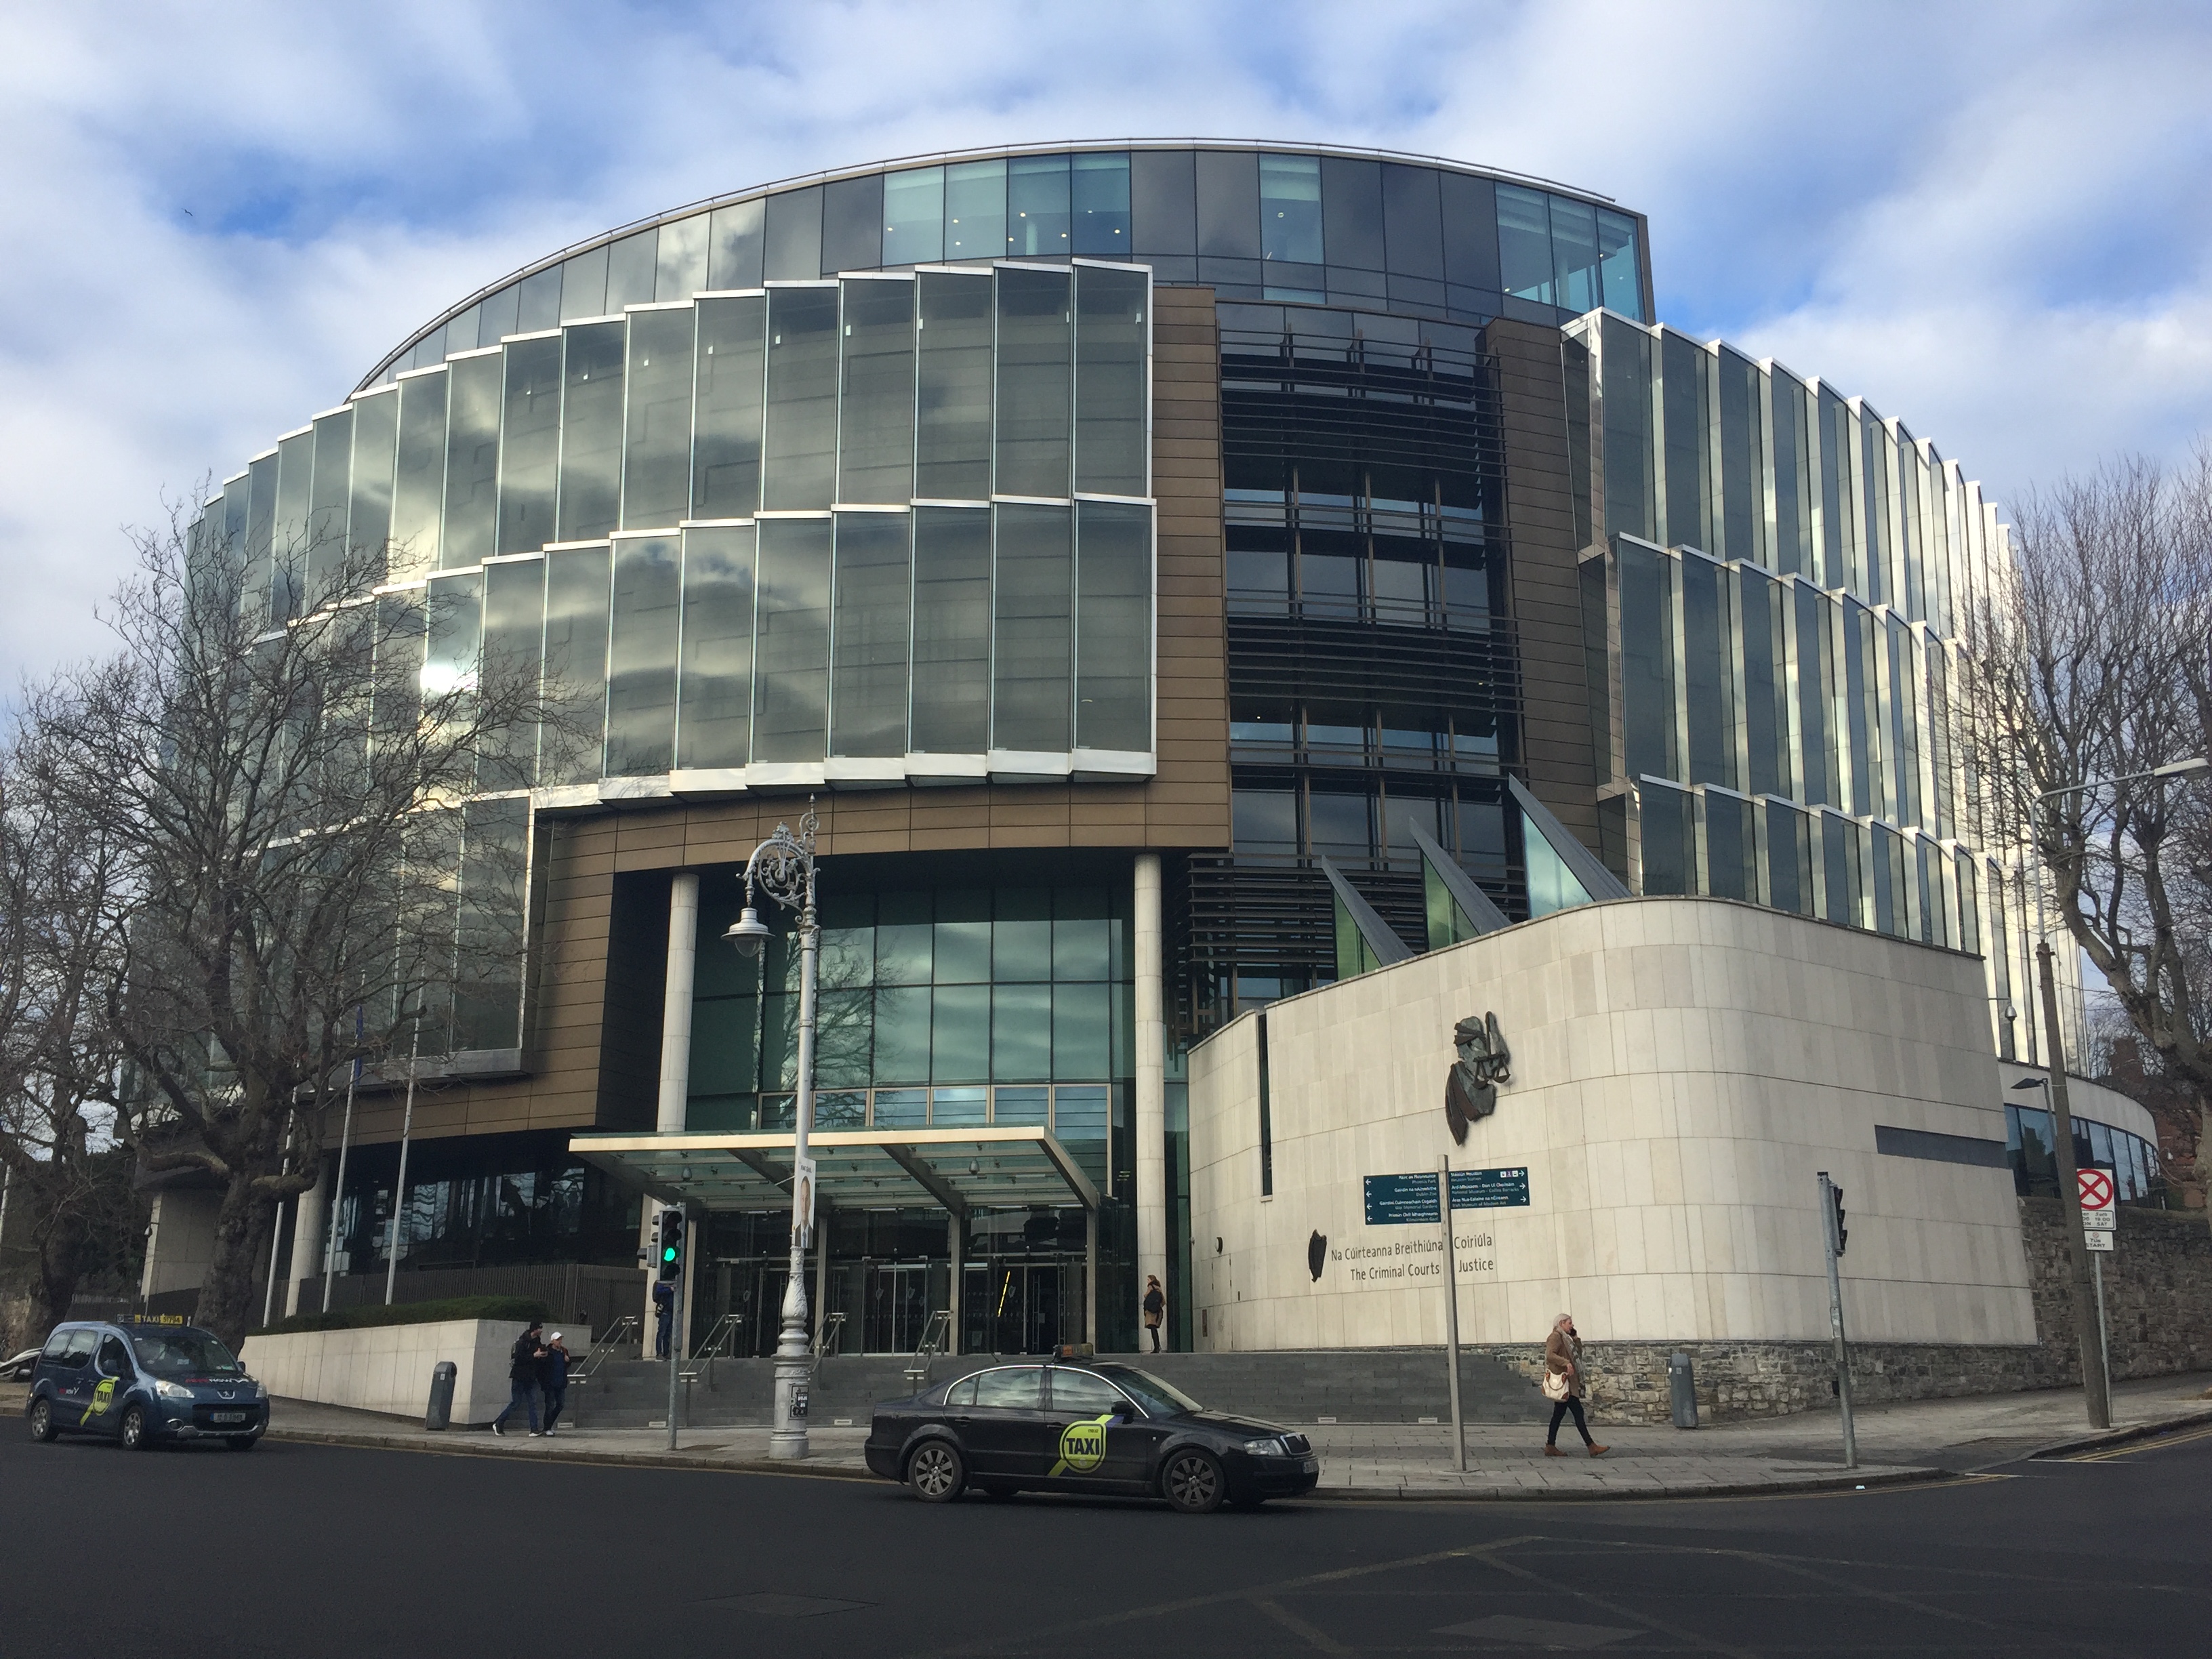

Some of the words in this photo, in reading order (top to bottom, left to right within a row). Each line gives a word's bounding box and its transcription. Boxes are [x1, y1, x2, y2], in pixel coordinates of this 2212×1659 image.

[1331, 1250, 1342, 1261] Na
[1345, 1246, 1392, 1261] Cúirteanna
[1395, 1240, 1443, 1256] Breithiúna
[1454, 1233, 1492, 1250] Coiriúla
[1351, 1268, 1366, 1281] The
[1369, 1265, 1405, 1279] Criminal
[1408, 1263, 1440, 1277] Courts
[1458, 1258, 1494, 1273] Justice
[97, 1391, 111, 1403] TAXI
[1066, 1438, 1099, 1455] TAXI
